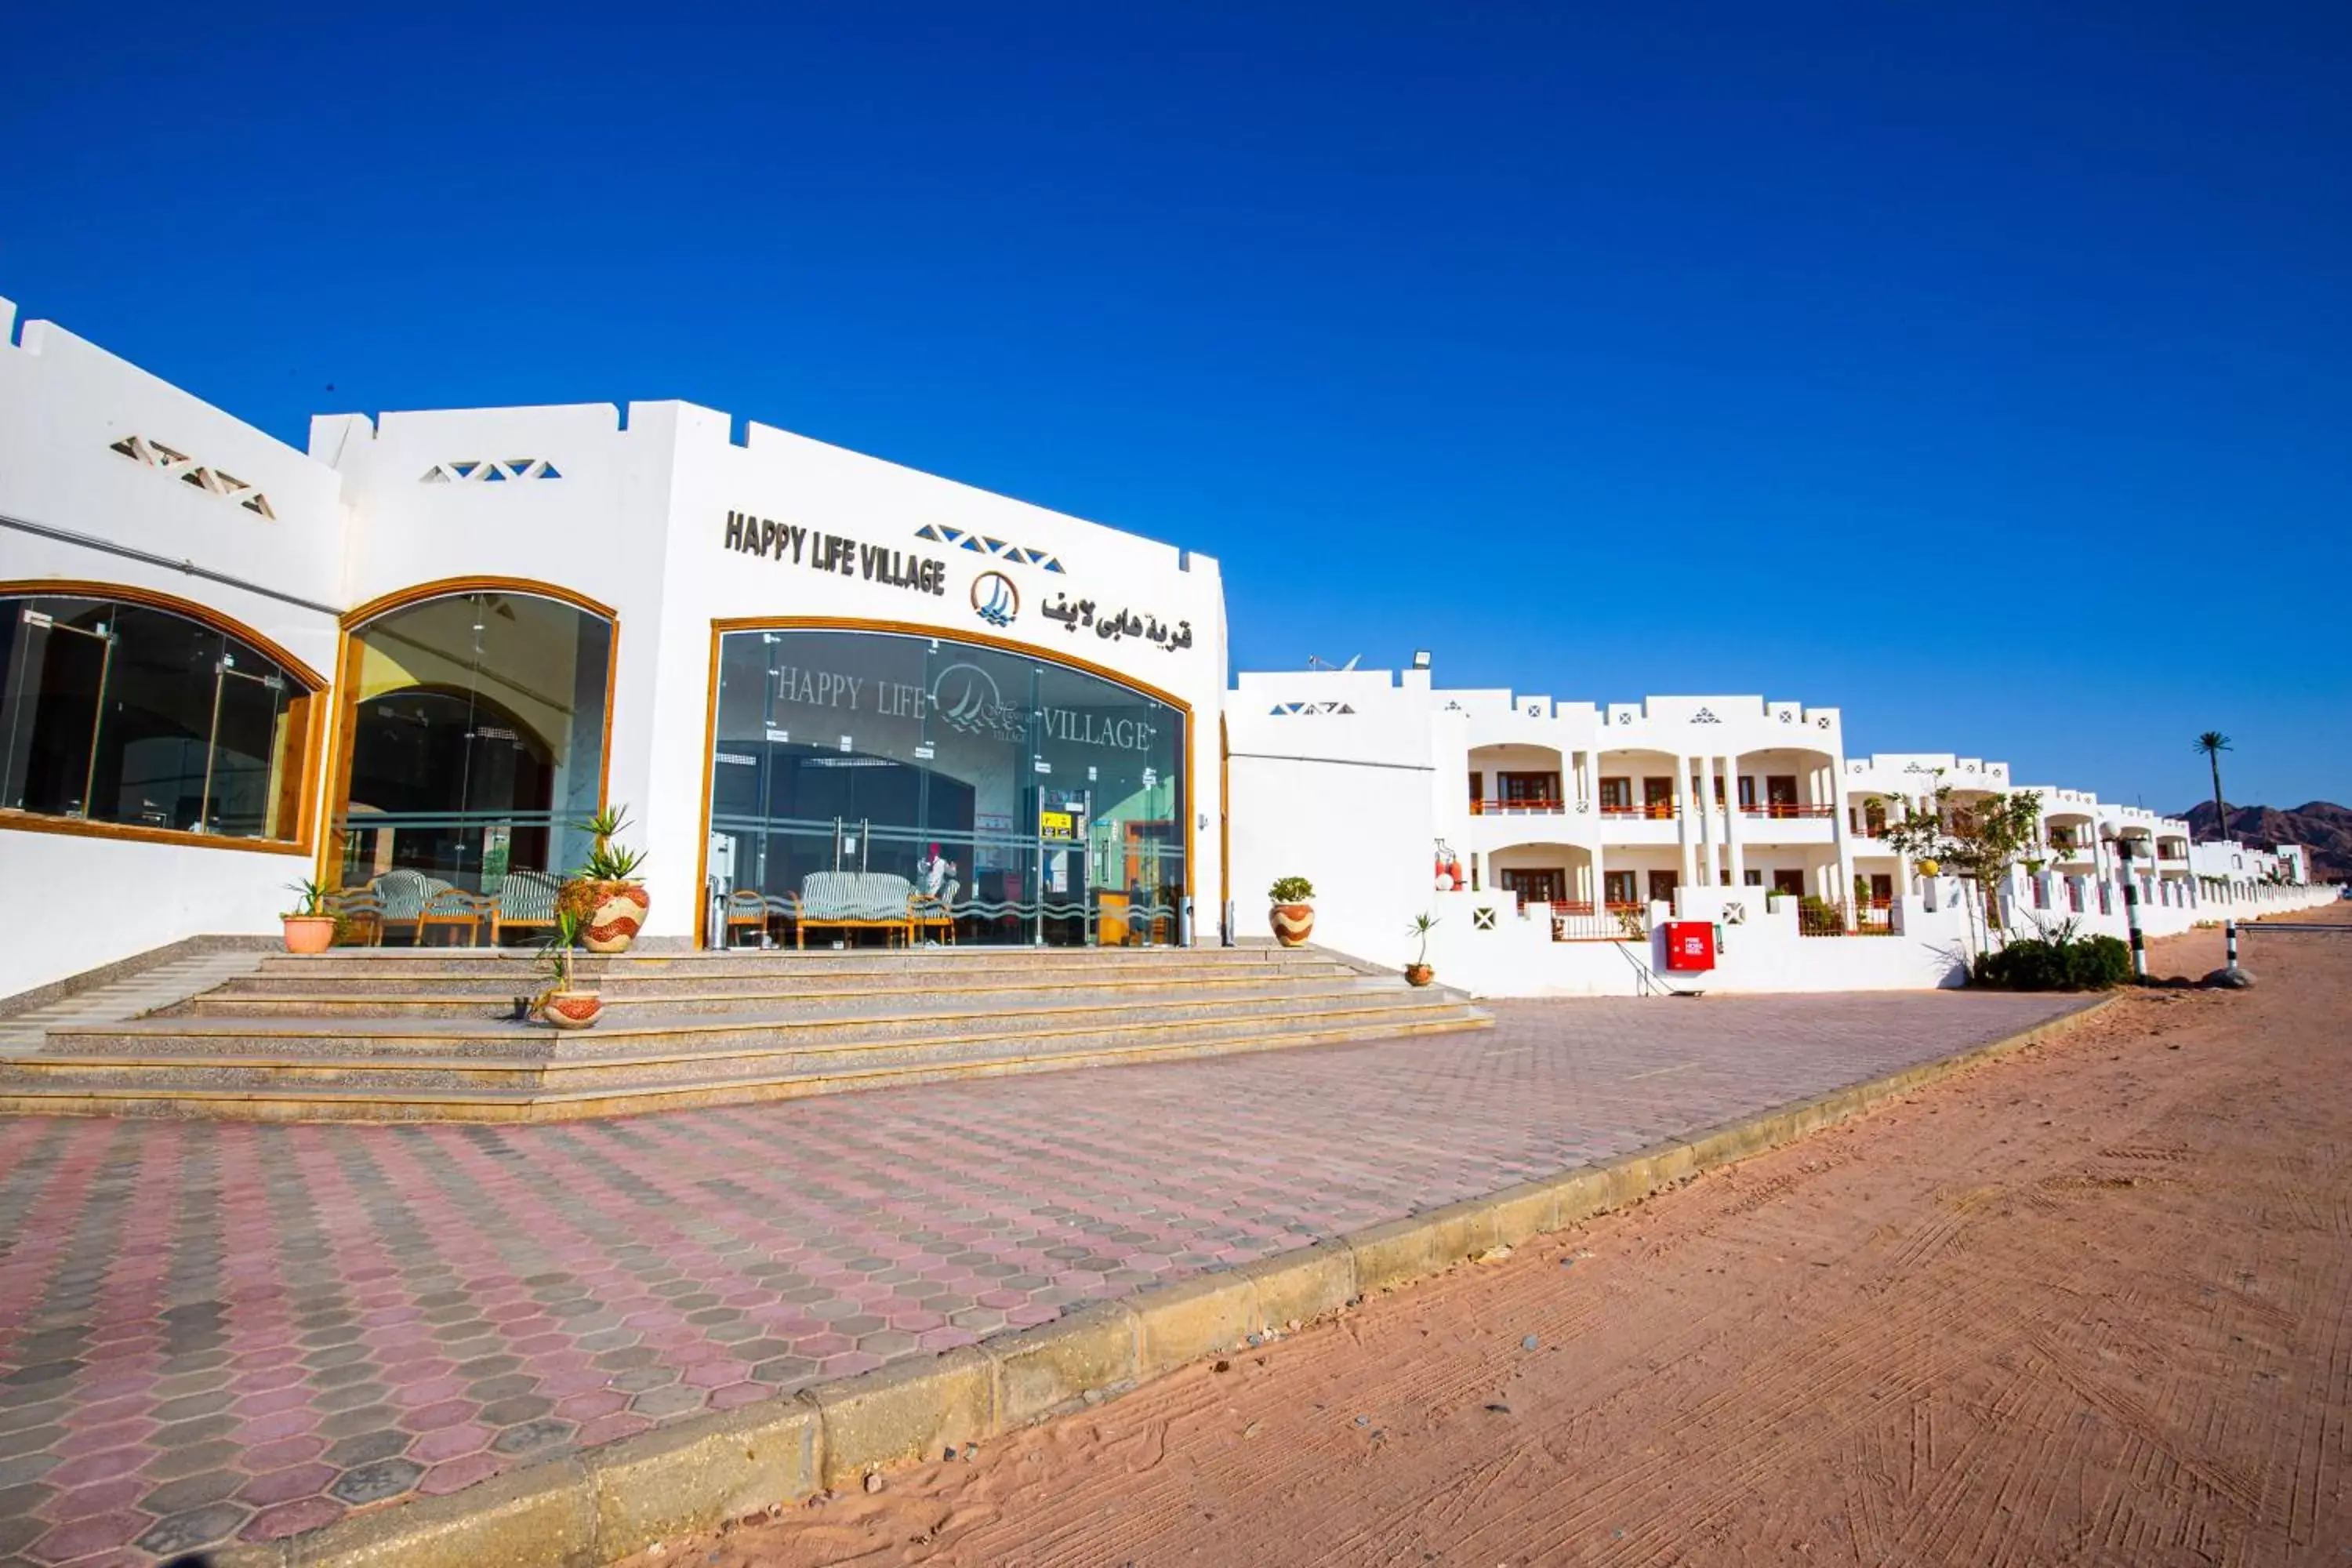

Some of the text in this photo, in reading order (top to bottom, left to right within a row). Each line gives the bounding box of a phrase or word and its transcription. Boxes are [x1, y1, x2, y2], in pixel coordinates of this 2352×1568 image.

[724, 510, 946, 597] HAPPY LIFE VILLAGE
[1041, 592, 1096, 633] لايف
[1145, 612, 1192, 652] قرية
[778, 665, 863, 710] HAPPY
[877, 681, 926, 719] LIFE
[1043, 706, 1150, 751] VILLAGE
